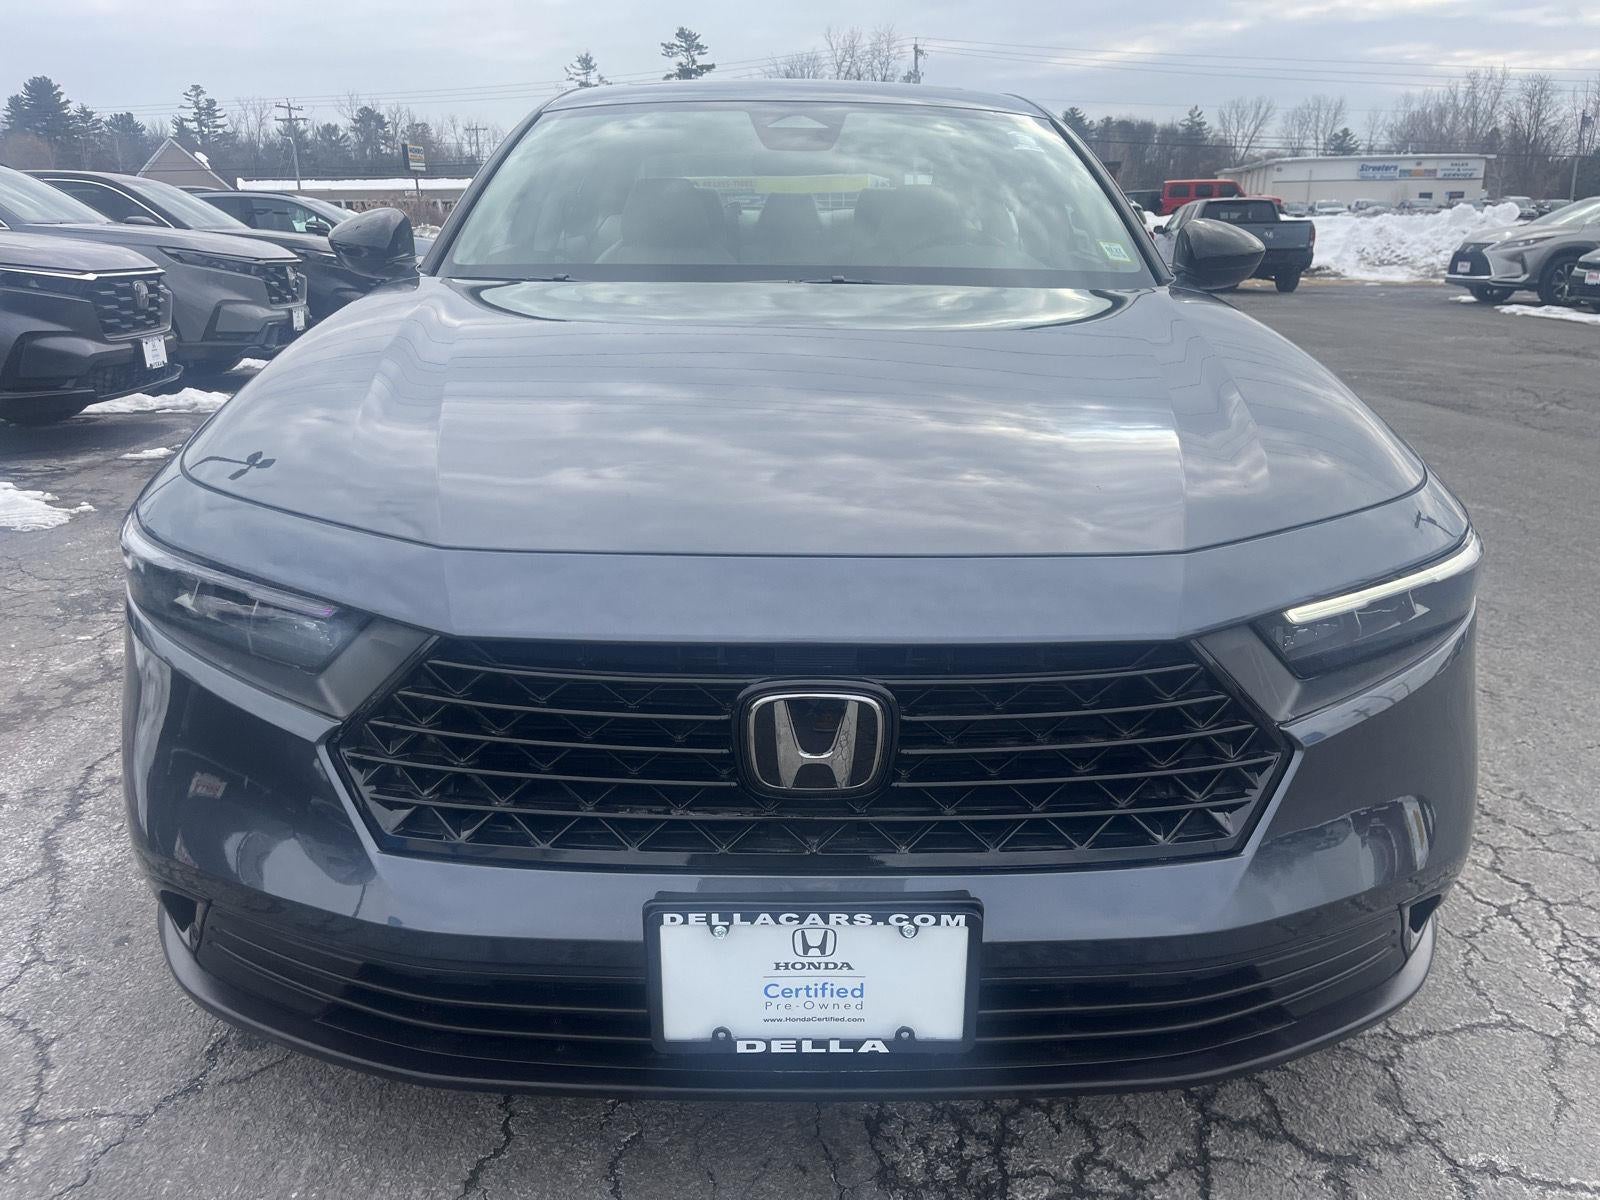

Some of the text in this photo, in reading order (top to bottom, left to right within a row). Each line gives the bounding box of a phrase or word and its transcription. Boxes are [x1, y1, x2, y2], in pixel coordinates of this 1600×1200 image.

[663, 912, 966, 927] DELLACARS.COM
[773, 961, 855, 971] HONDA
[763, 982, 865, 999] Certified
[764, 1001, 864, 1011] Pre-Owned
[735, 1039, 890, 1054] DELLA
